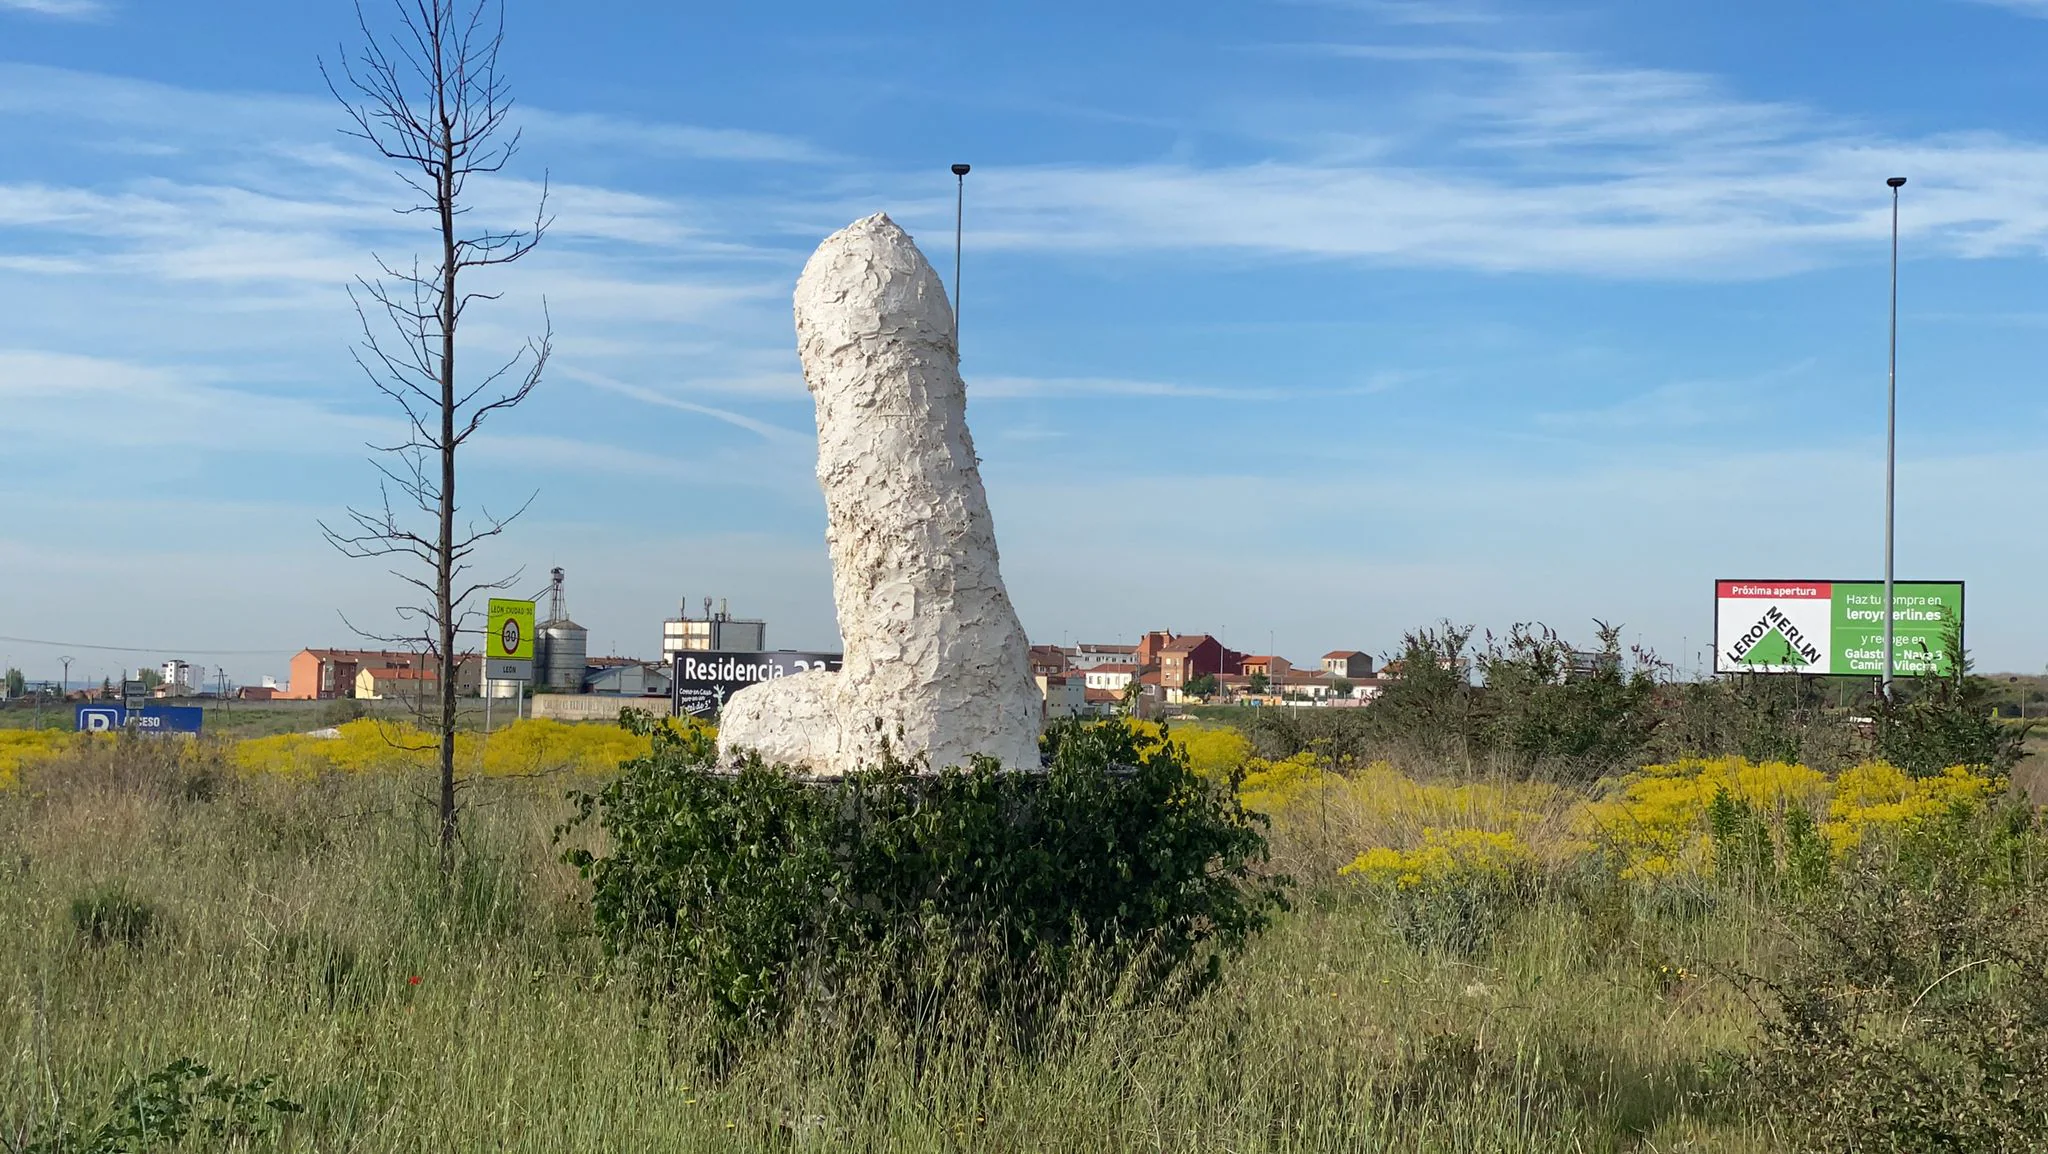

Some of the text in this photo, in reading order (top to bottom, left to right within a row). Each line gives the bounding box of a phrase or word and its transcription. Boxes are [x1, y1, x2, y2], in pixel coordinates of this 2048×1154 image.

[1732, 585, 1817, 597] Próxima apertura
[1846, 594, 1941, 606] Haz tu ompra en
[506, 630, 516, 642] 30
[1726, 605, 1822, 664] LEROY MERLIN
[1861, 635, 1925, 647] y rege en
[1935, 650, 1943, 661] 3
[685, 657, 784, 682] Residencia
[1850, 659, 1884, 670] Camin
